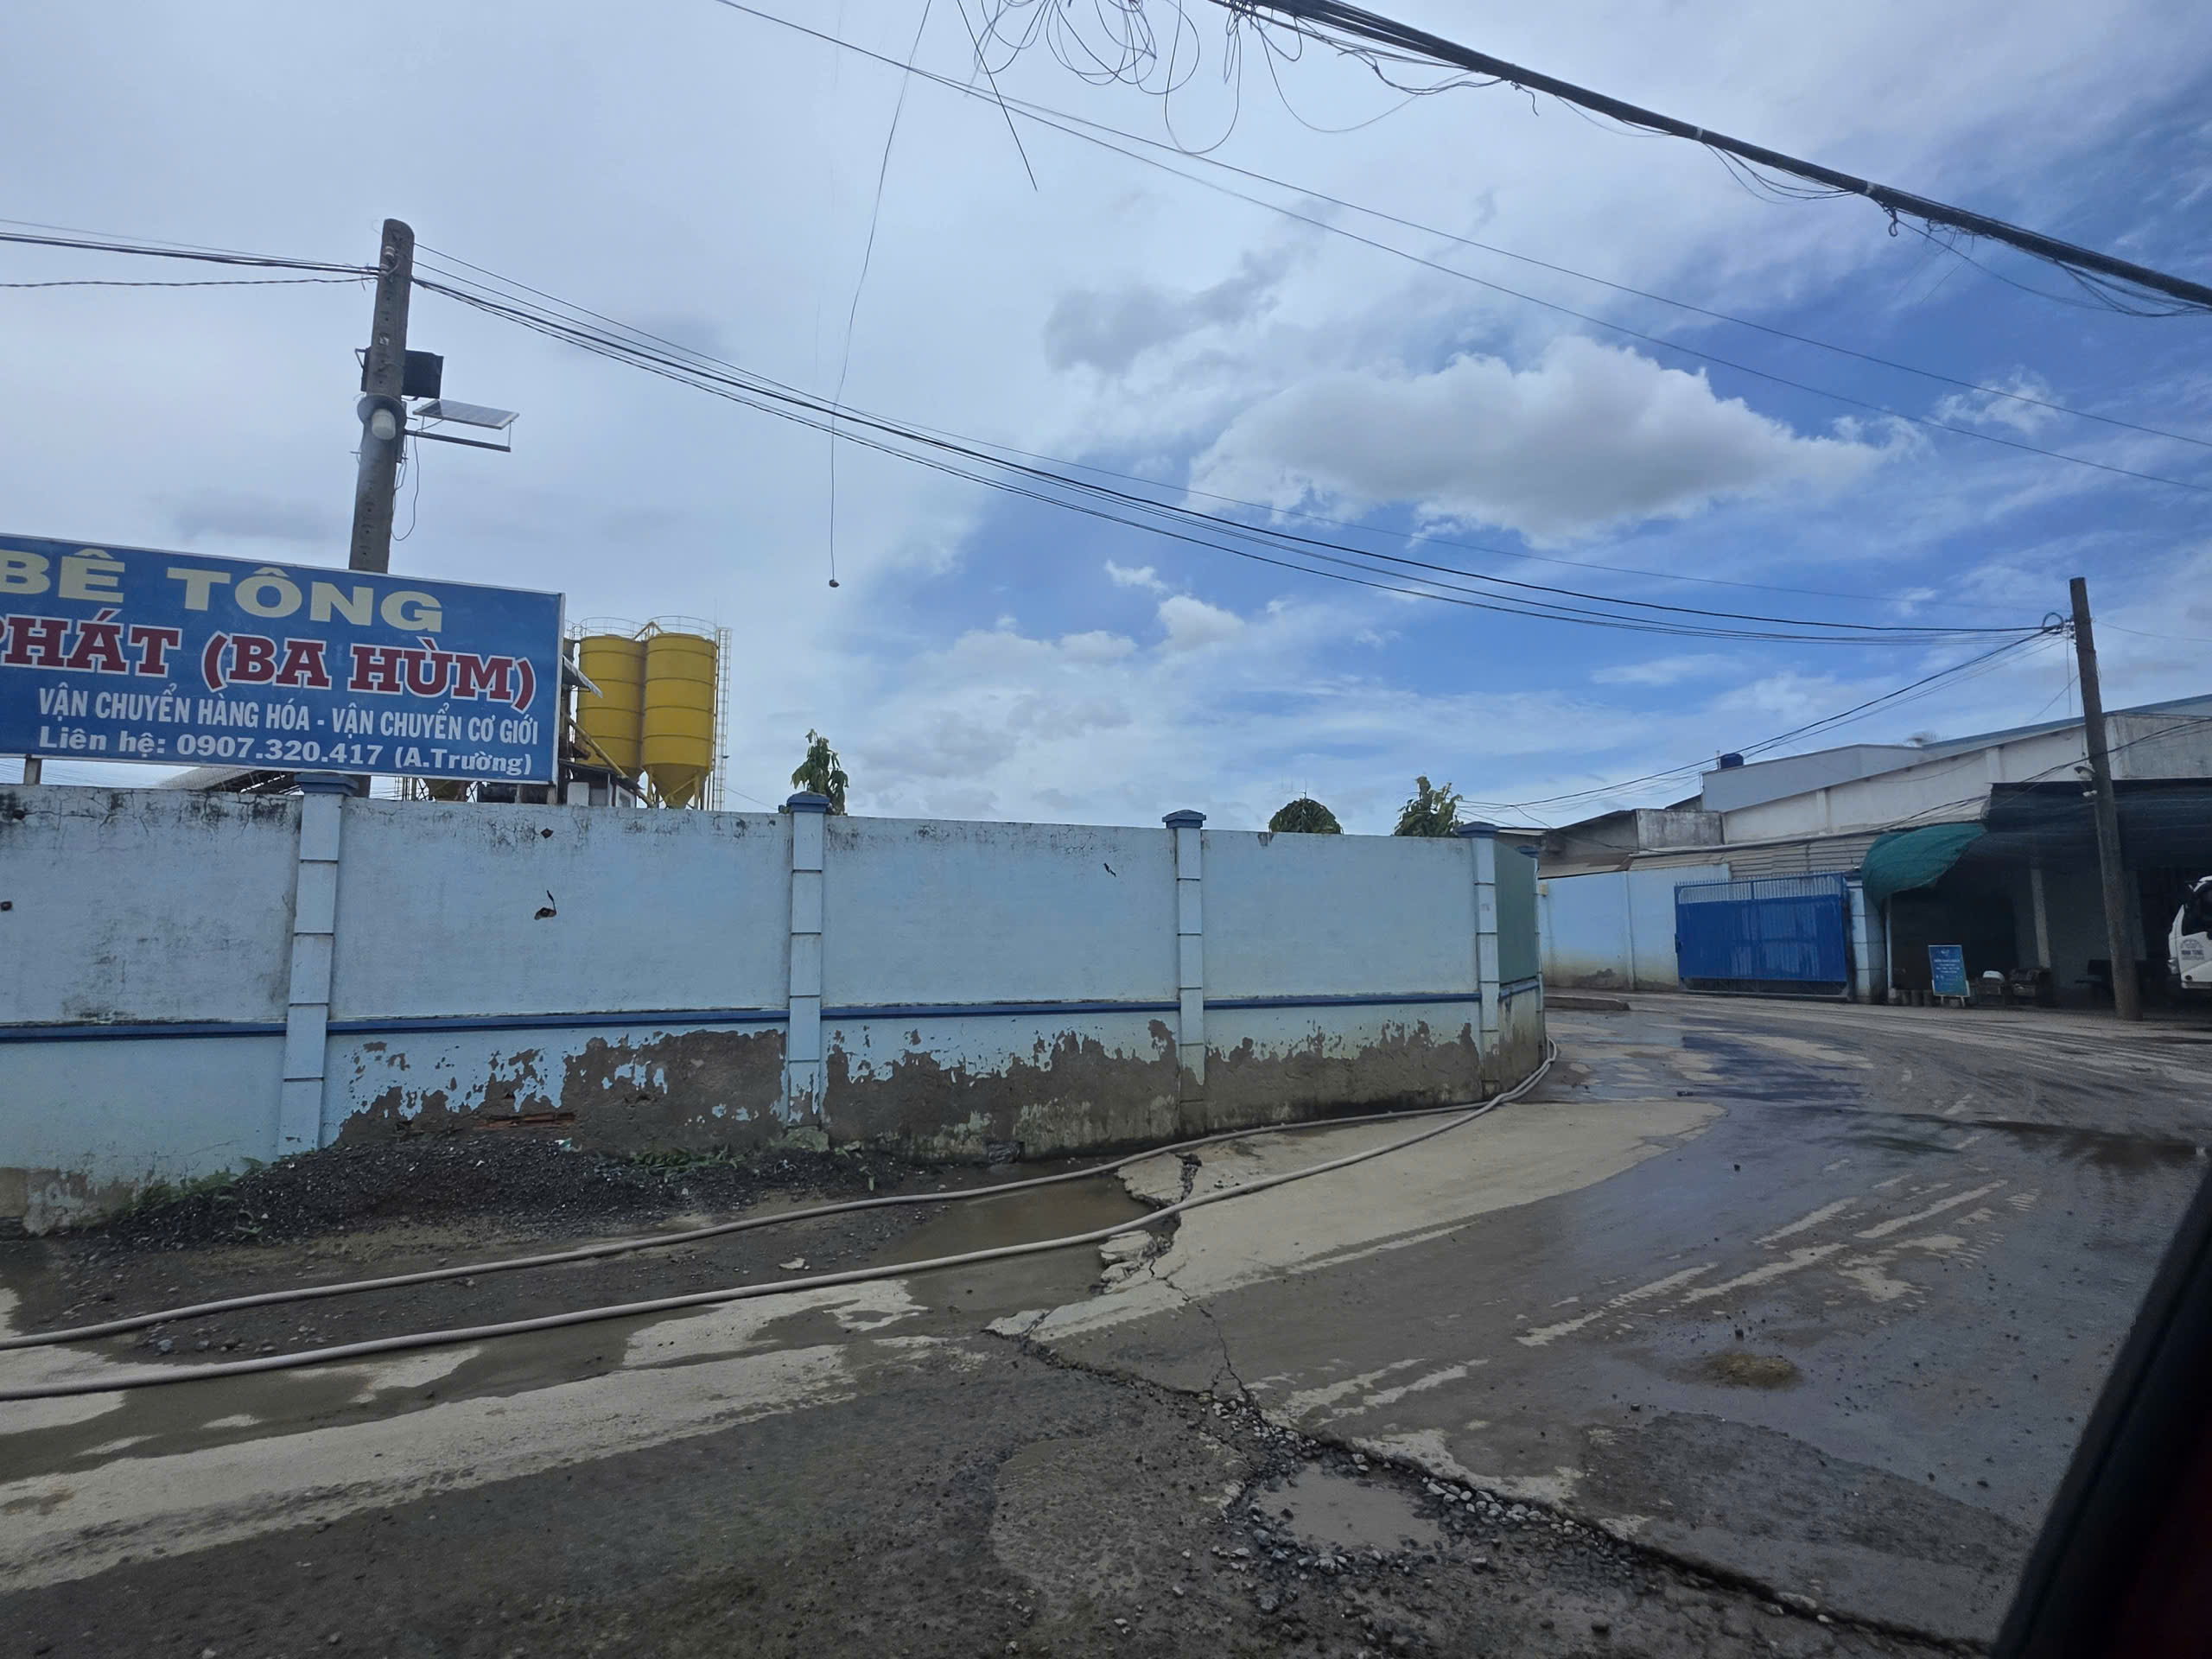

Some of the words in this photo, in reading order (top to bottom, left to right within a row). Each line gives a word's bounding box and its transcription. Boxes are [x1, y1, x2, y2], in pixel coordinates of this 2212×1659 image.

[0, 548, 125, 603] BÊ
[167, 567, 442, 632] TÔNG
[0, 607, 183, 677] HÁT
[201, 630, 332, 692] (BA
[347, 636, 536, 714] HÙM)
[39, 682, 88, 721] VẬN
[95, 683, 191, 723] CHUYỂN
[197, 693, 259, 728] HÀNG
[265, 698, 310, 731] HÓA
[332, 702, 374, 739] VẬN
[380, 702, 462, 741] CHUYỂN
[467, 715, 496, 743] CƠ
[499, 714, 539, 745] GIỚI
[39, 726, 107, 751] Liên
[118, 730, 166, 758] hệ:
[177, 734, 384, 765] 0907.320.417
[395, 747, 531, 776] (A.Trường)
